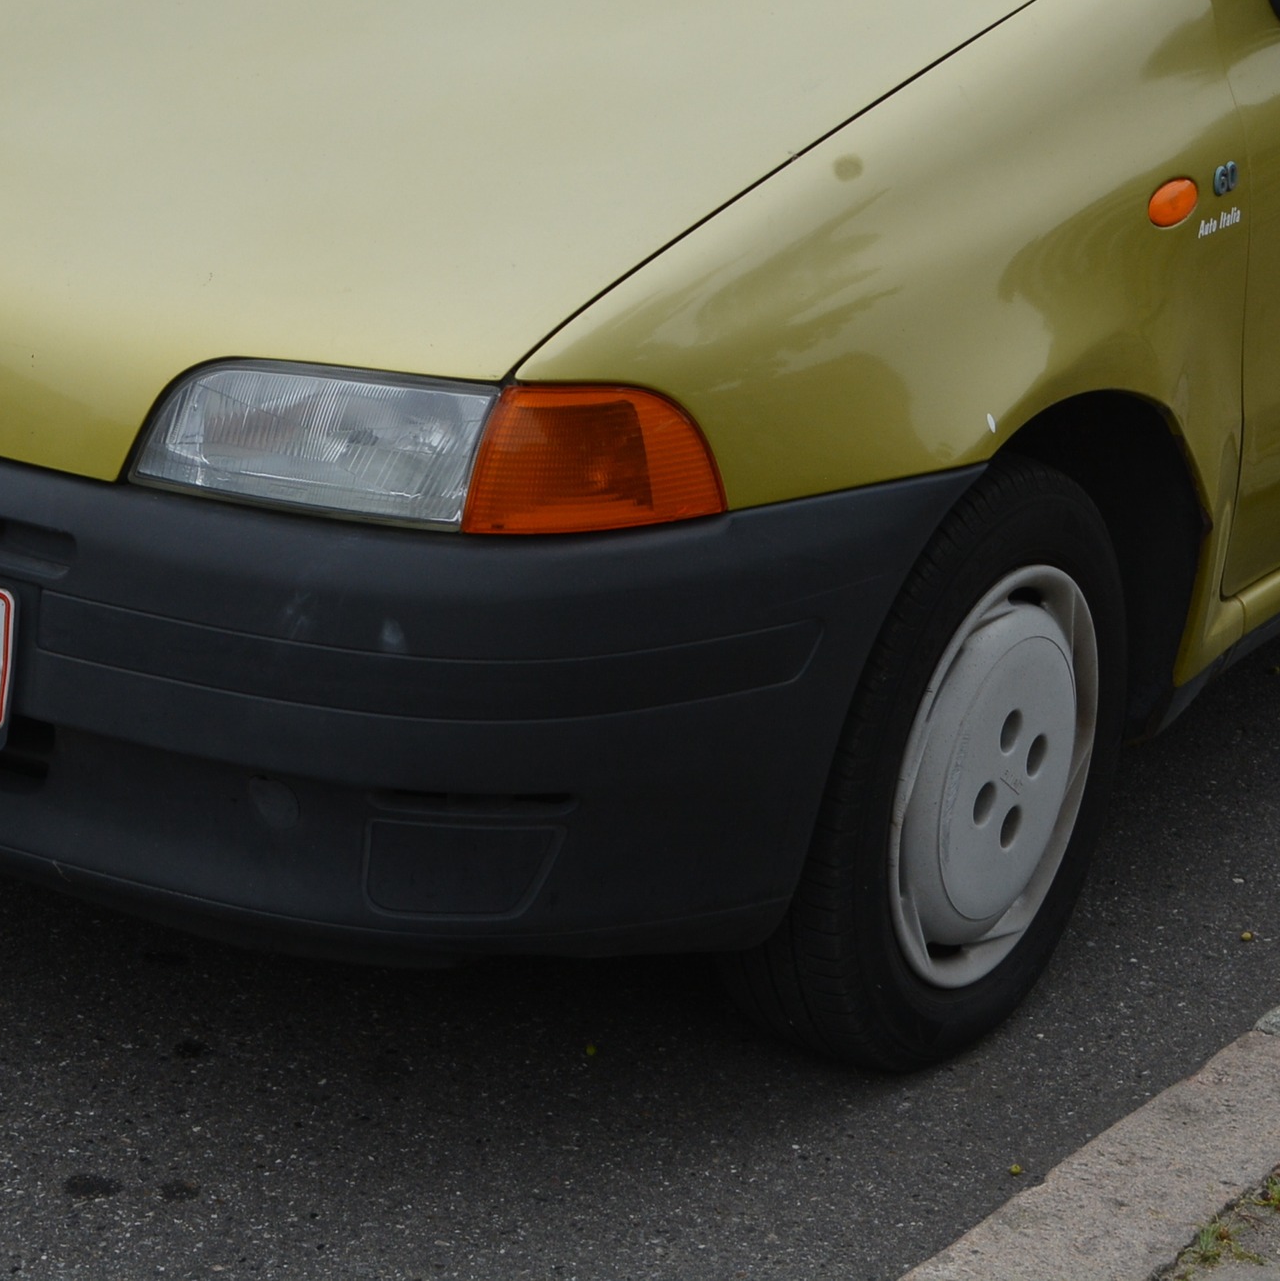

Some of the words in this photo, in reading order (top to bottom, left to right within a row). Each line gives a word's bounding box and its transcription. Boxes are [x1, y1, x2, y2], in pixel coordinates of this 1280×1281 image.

[1214, 160, 1238, 196] 60
[1198, 217, 1217, 239] Auto
[1219, 206, 1241, 230] Italia
